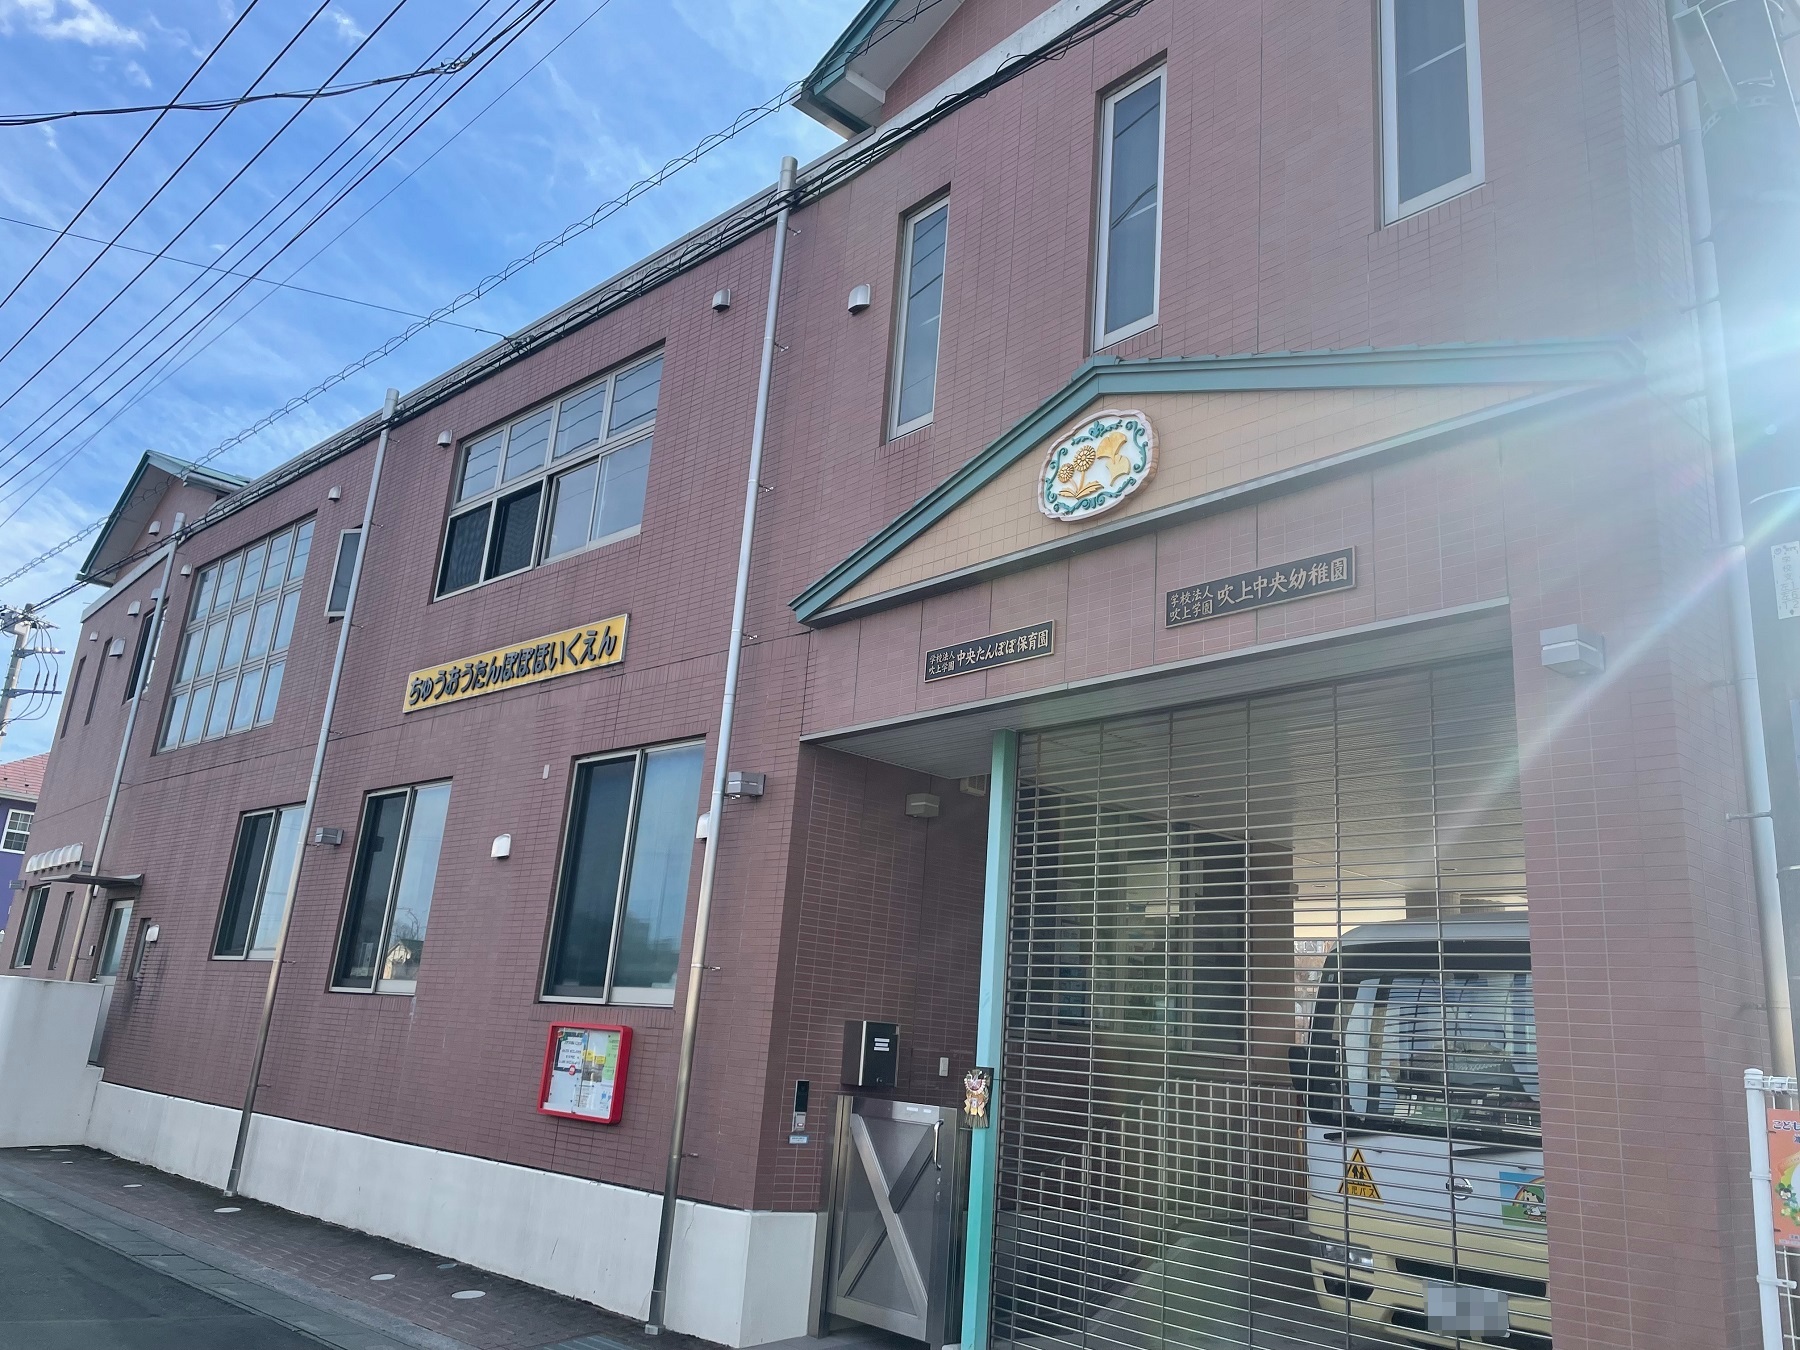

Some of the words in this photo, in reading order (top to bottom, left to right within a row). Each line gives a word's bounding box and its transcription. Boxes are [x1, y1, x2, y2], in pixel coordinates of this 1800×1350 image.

[1217, 556, 1348, 608] 吹上中央幼稚園
[1169, 585, 1214, 608] 学校法人
[1169, 599, 1213, 622] 吹上学園
[929, 650, 956, 665] 学校法人
[956, 628, 1049, 667] 中央たんぽぽ保育園
[408, 625, 618, 706] ちゅうおうたんぽぽほいくえん
[928, 660, 955, 675] 吹上学園
